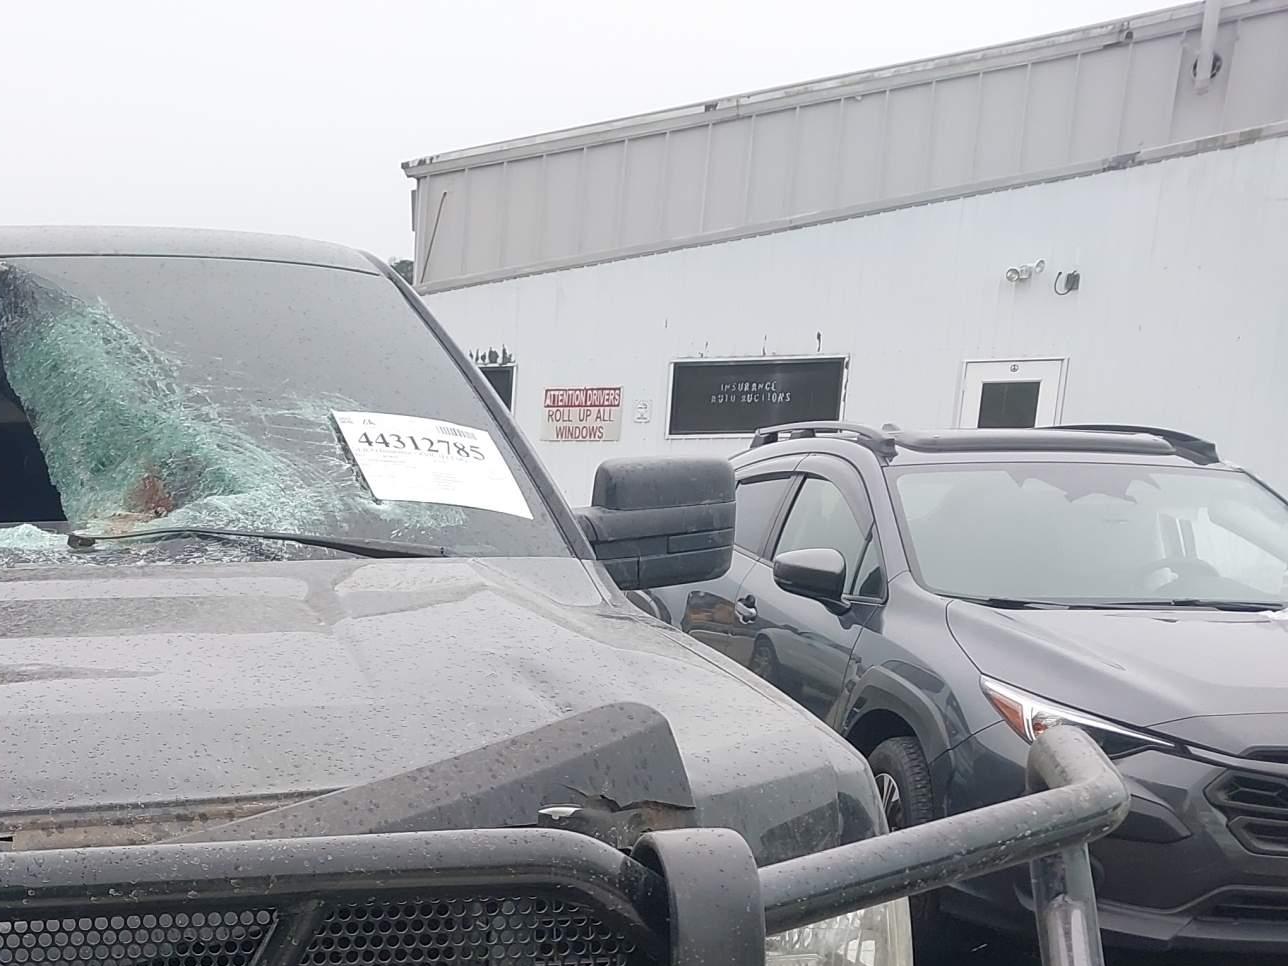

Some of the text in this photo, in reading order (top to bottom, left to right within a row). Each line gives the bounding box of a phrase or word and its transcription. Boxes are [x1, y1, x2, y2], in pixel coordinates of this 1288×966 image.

[720, 381, 777, 392] INSURANCE
[545, 389, 620, 406] ATTENTION DRIVERS
[547, 408, 615, 422] ROLL UP ALL
[555, 425, 604, 440] WINDOWS
[358, 431, 486, 461] 44312785
